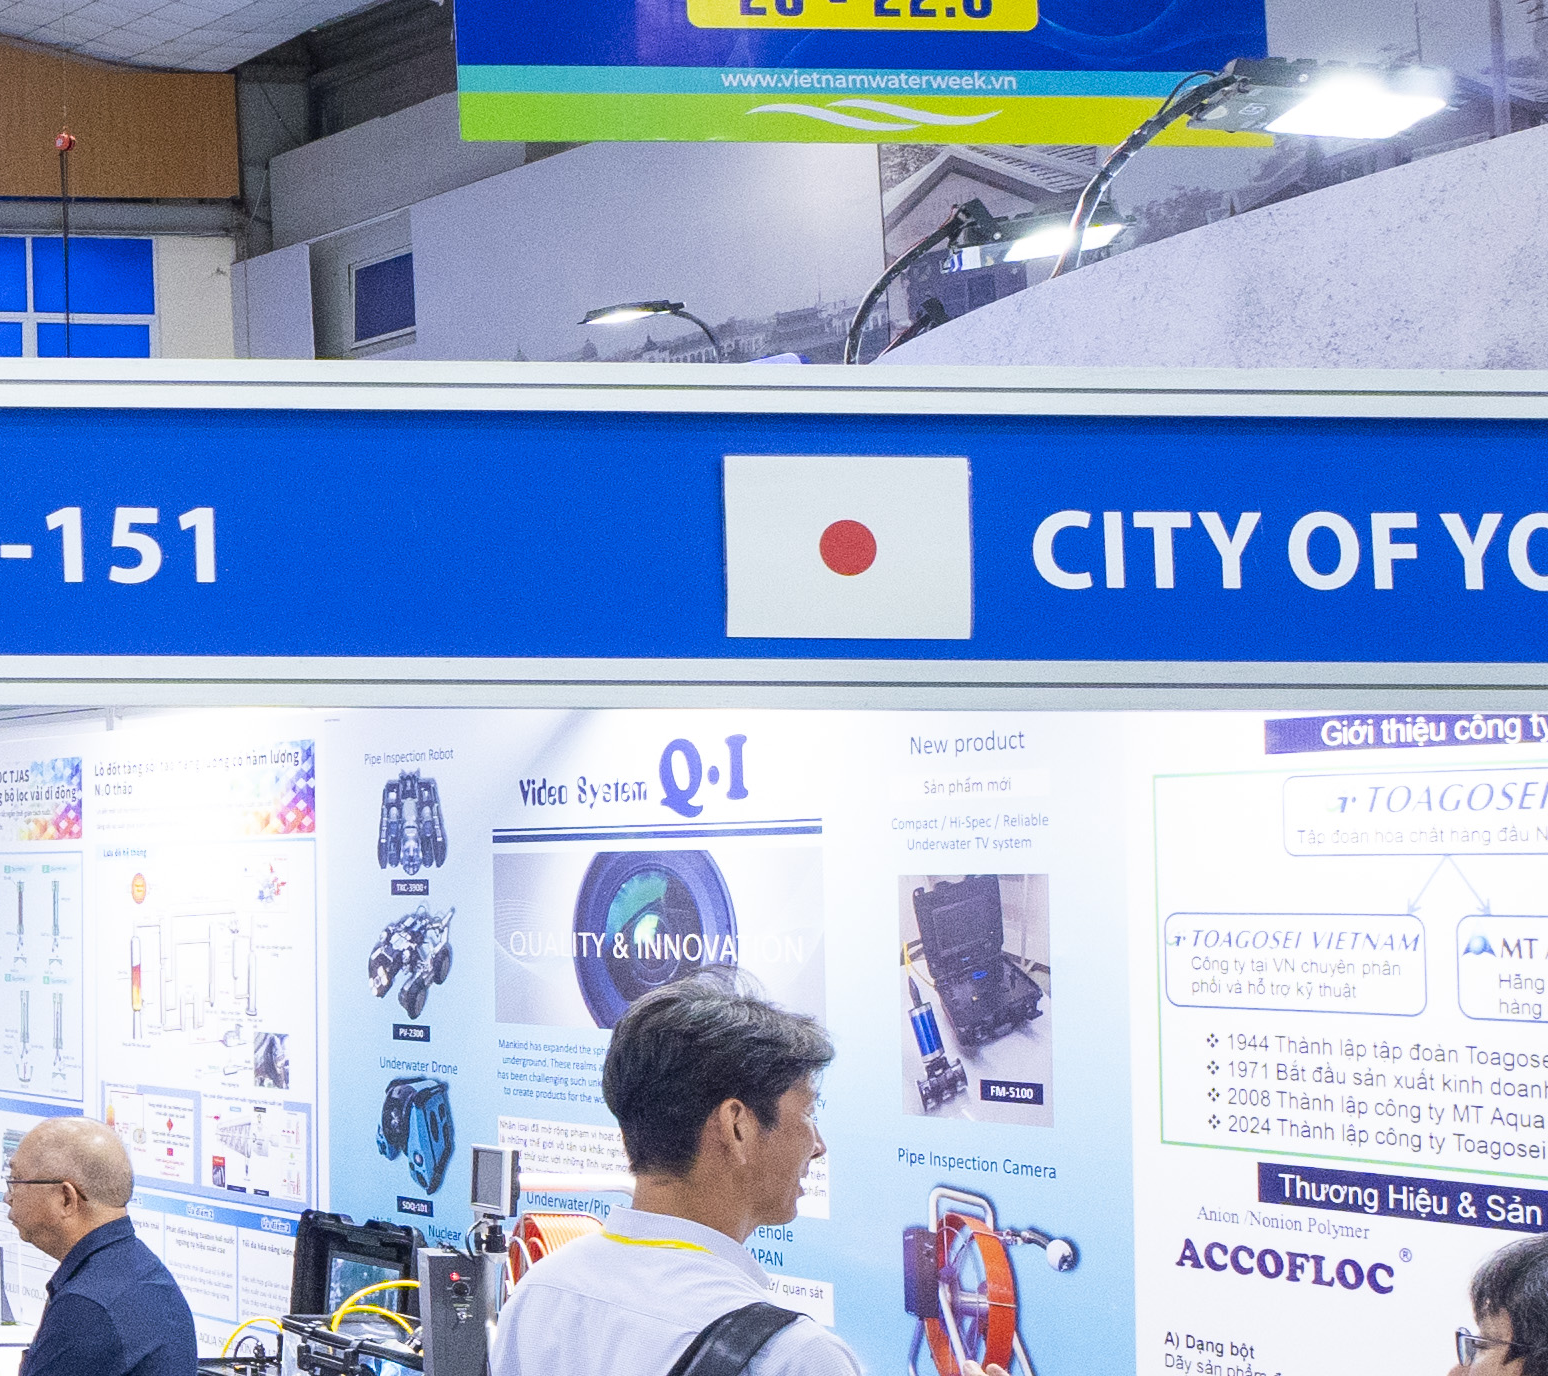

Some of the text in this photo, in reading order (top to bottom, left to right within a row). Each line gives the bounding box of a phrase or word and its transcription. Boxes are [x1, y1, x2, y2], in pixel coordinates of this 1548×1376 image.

[720, 67, 1018, 91] www.vietnamwaterweek.vn
[1032, 509, 1262, 590] CITY
[1288, 511, 1419, 592] OF
[911, 730, 1025, 757] New product
[1320, 714, 1521, 746] Giới thiệu công
[364, 748, 454, 766] Pipe Inspection Robot
[519, 778, 568, 807] Video
[576, 776, 648, 808] System
[509, 930, 804, 963] QUALITY & INNOVATON
[379, 1057, 458, 1075] Underwater Drone
[990, 1085, 1033, 1100] FM-5100
[898, 1147, 1057, 1180] Pipe Inspection Camera
[1278, 1173, 1542, 1226] Thương Hiệu & Sản
[1175, 1237, 1395, 1296] ACCOFLOC
[1164, 1331, 1255, 1361] A) Dạng bột
